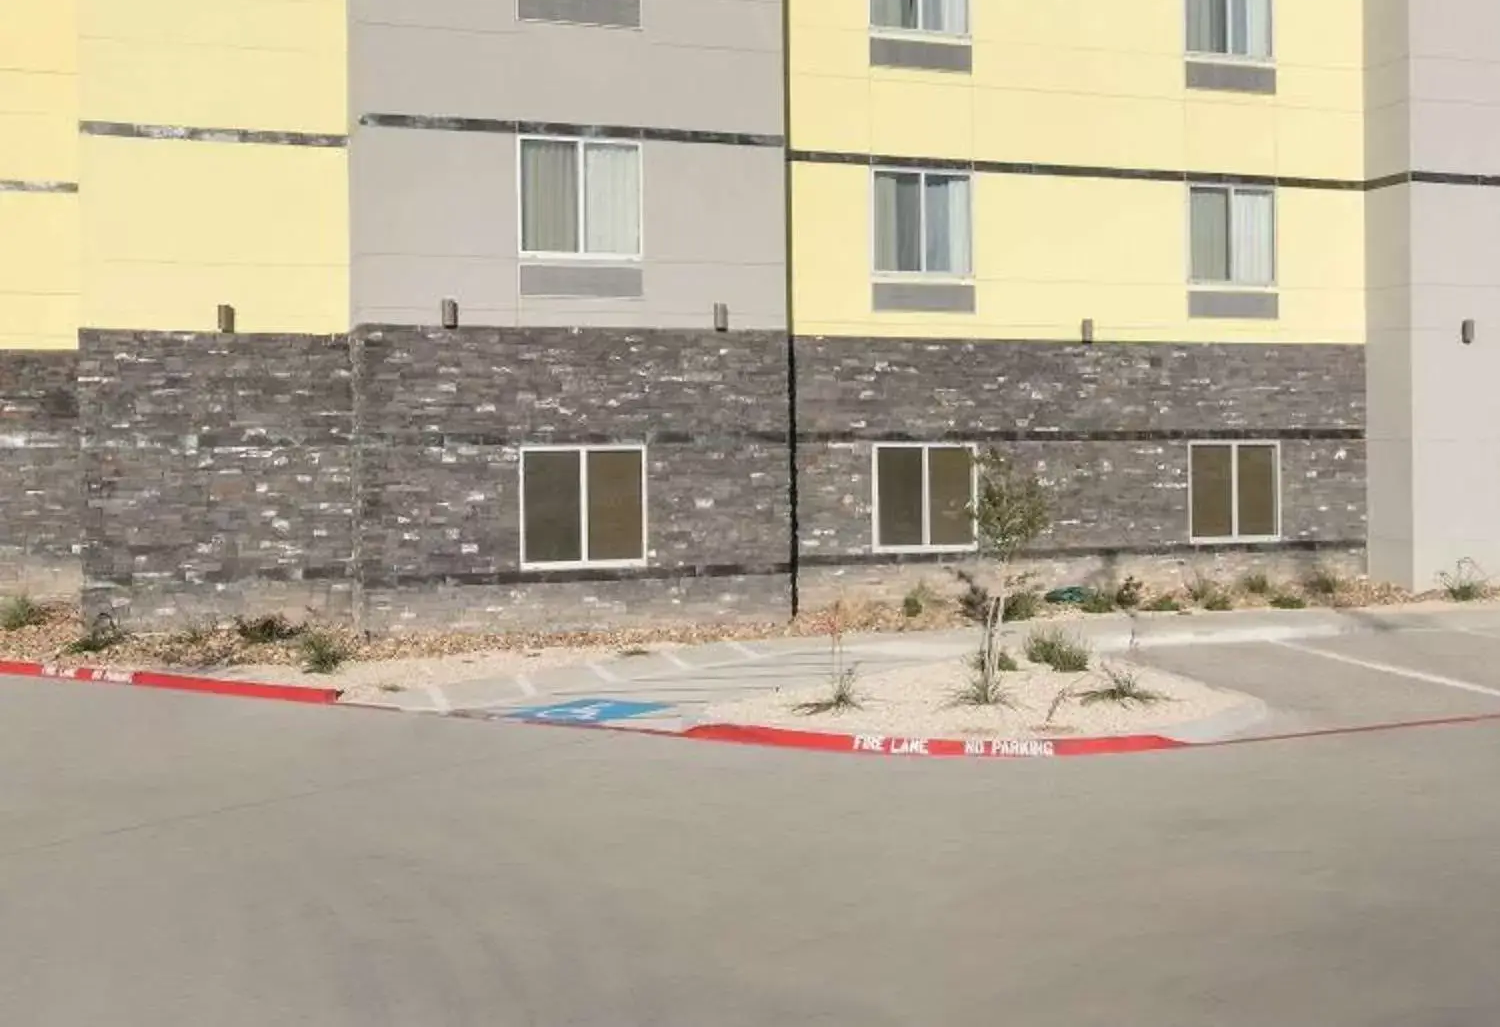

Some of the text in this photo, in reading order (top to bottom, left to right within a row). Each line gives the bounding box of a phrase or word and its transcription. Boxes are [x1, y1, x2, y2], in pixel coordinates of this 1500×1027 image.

[853, 734, 1054, 756] FIRE LANE NO PARKING
